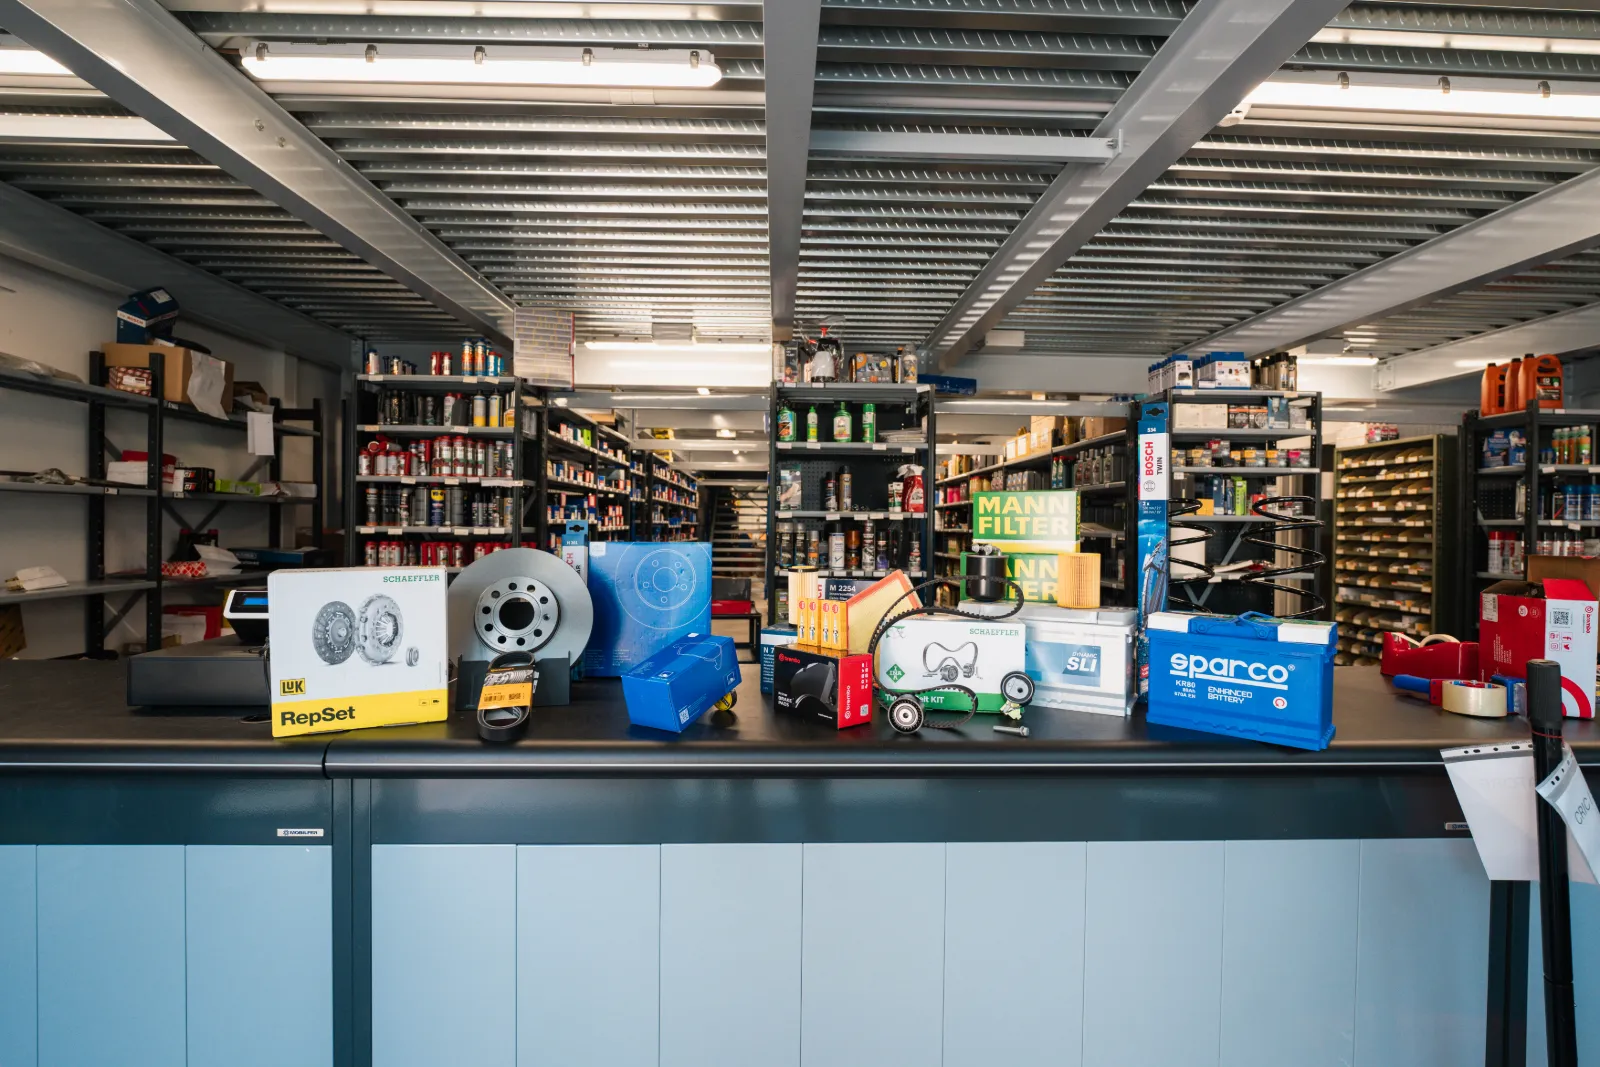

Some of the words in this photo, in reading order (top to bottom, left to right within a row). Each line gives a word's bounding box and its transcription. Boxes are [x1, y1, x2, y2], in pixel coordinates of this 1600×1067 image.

[1145, 441, 1154, 476] BOSCH
[978, 495, 1069, 515] MANN
[978, 516, 1069, 535] FILTER
[1006, 558, 1058, 578] NN
[383, 574, 440, 583] SCHAEFFLER
[969, 628, 1019, 637] SCHAEFFLER
[1072, 651, 1098, 659] DYNAMIC
[1066, 656, 1098, 672] SLI
[1175, 679, 1196, 688] KR80
[1207, 686, 1253, 699] ENHANCED
[1207, 693, 1244, 704] BATTERY
[280, 705, 356, 727] RepSet
